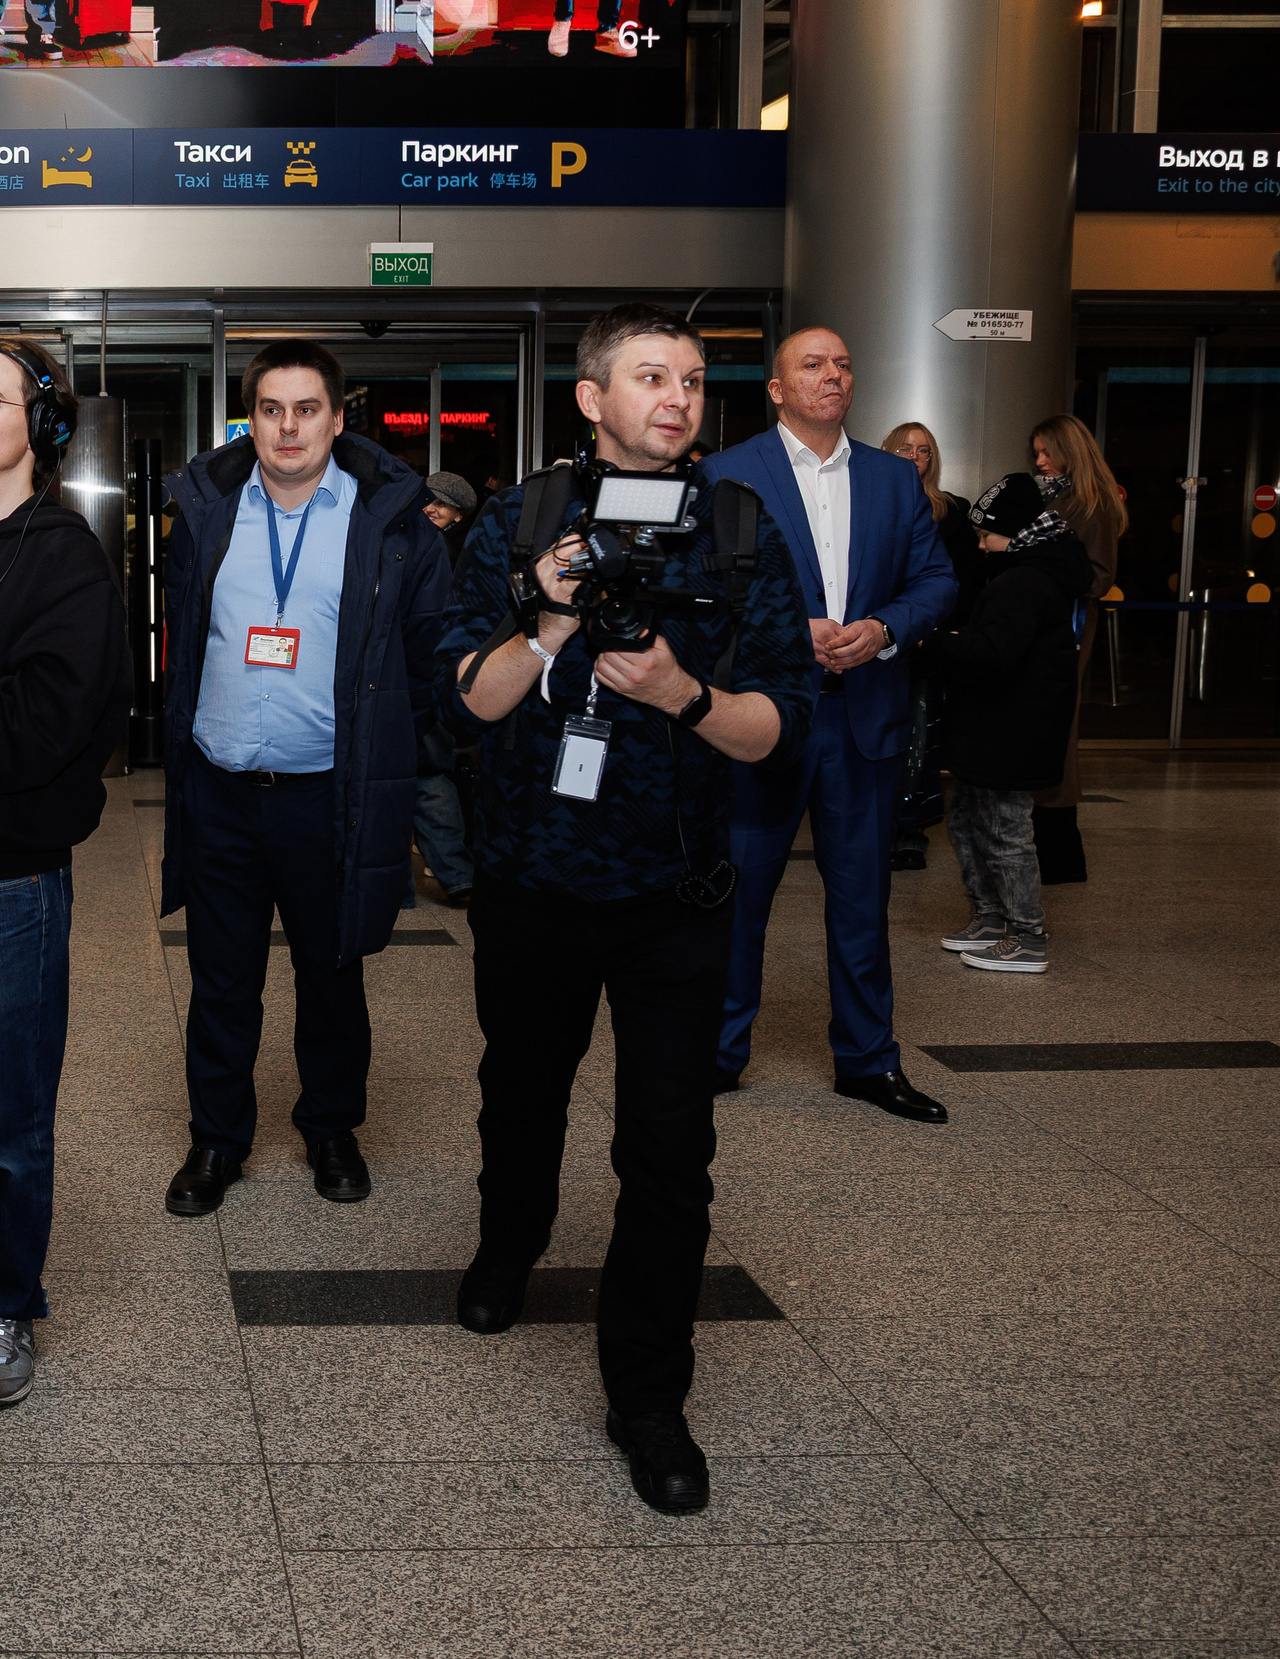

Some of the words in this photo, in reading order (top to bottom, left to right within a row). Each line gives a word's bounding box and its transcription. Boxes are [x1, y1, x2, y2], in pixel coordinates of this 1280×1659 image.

[618, 20, 661, 50] 6+
[174, 140, 252, 163] Такси
[401, 140, 519, 168] Паркинг
[1159, 146, 1245, 171] Выход
[1252, 150, 1269, 168] в
[174, 172, 211, 189] Taxi
[222, 172, 270, 189] 出租车
[401, 172, 433, 188] Car
[437, 171, 479, 191] park
[490, 172, 537, 189] 停车场
[1157, 177, 1189, 193] Exit
[1195, 178, 1214, 193] to
[1220, 178, 1249, 193] the
[374, 257, 429, 274] ВЫХОД
[393, 275, 409, 283] EXIT
[973, 311, 1020, 320] УБЕЖИЩЕ
[966, 320, 978, 328] №
[980, 320, 1024, 329] 016530-77
[383, 412, 423, 425] ВЪЕЗД
[439, 412, 490, 424] ПАРКИНГ
